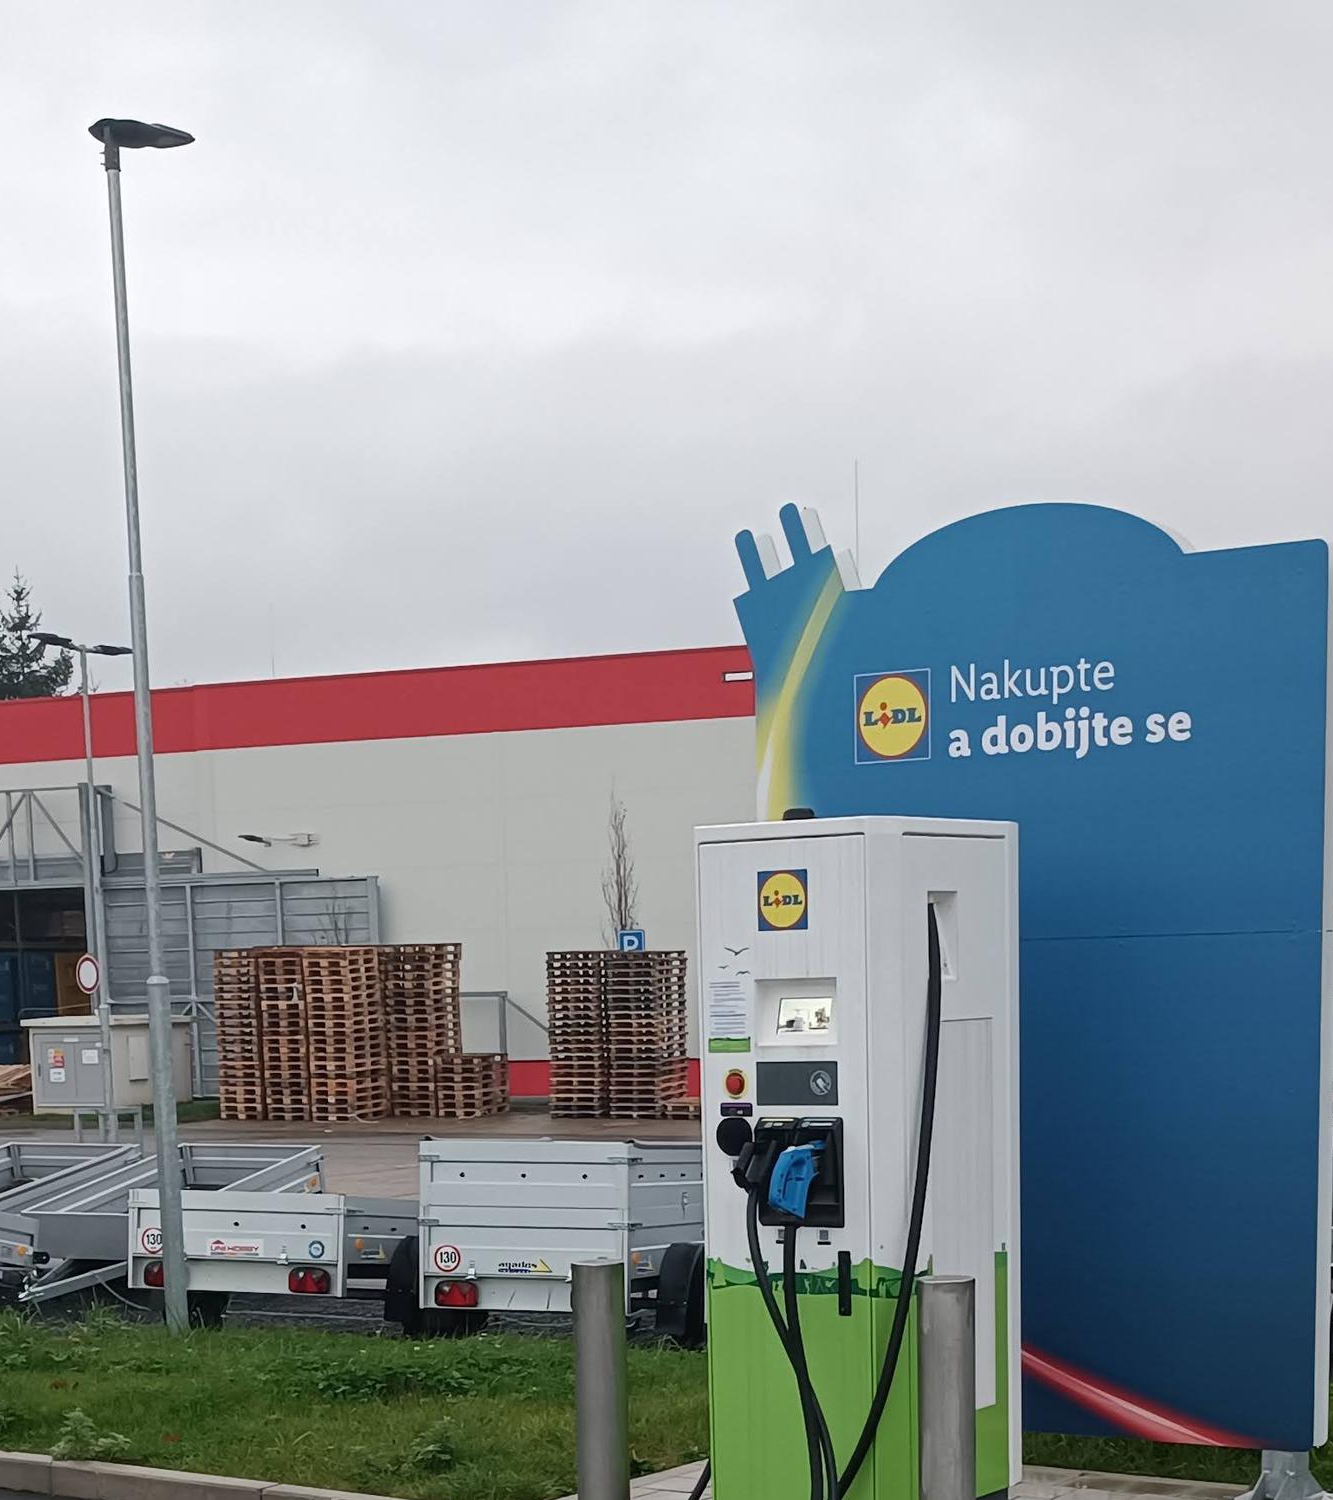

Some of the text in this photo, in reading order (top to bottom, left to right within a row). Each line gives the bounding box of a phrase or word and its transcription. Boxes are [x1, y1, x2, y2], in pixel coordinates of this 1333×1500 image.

[950, 658, 1115, 704] Nakupte
[948, 706, 1192, 759] a dobijte se
[623, 935, 639, 951] P
[146, 1234, 162, 1246] 130
[439, 1251, 457, 1264] 130
